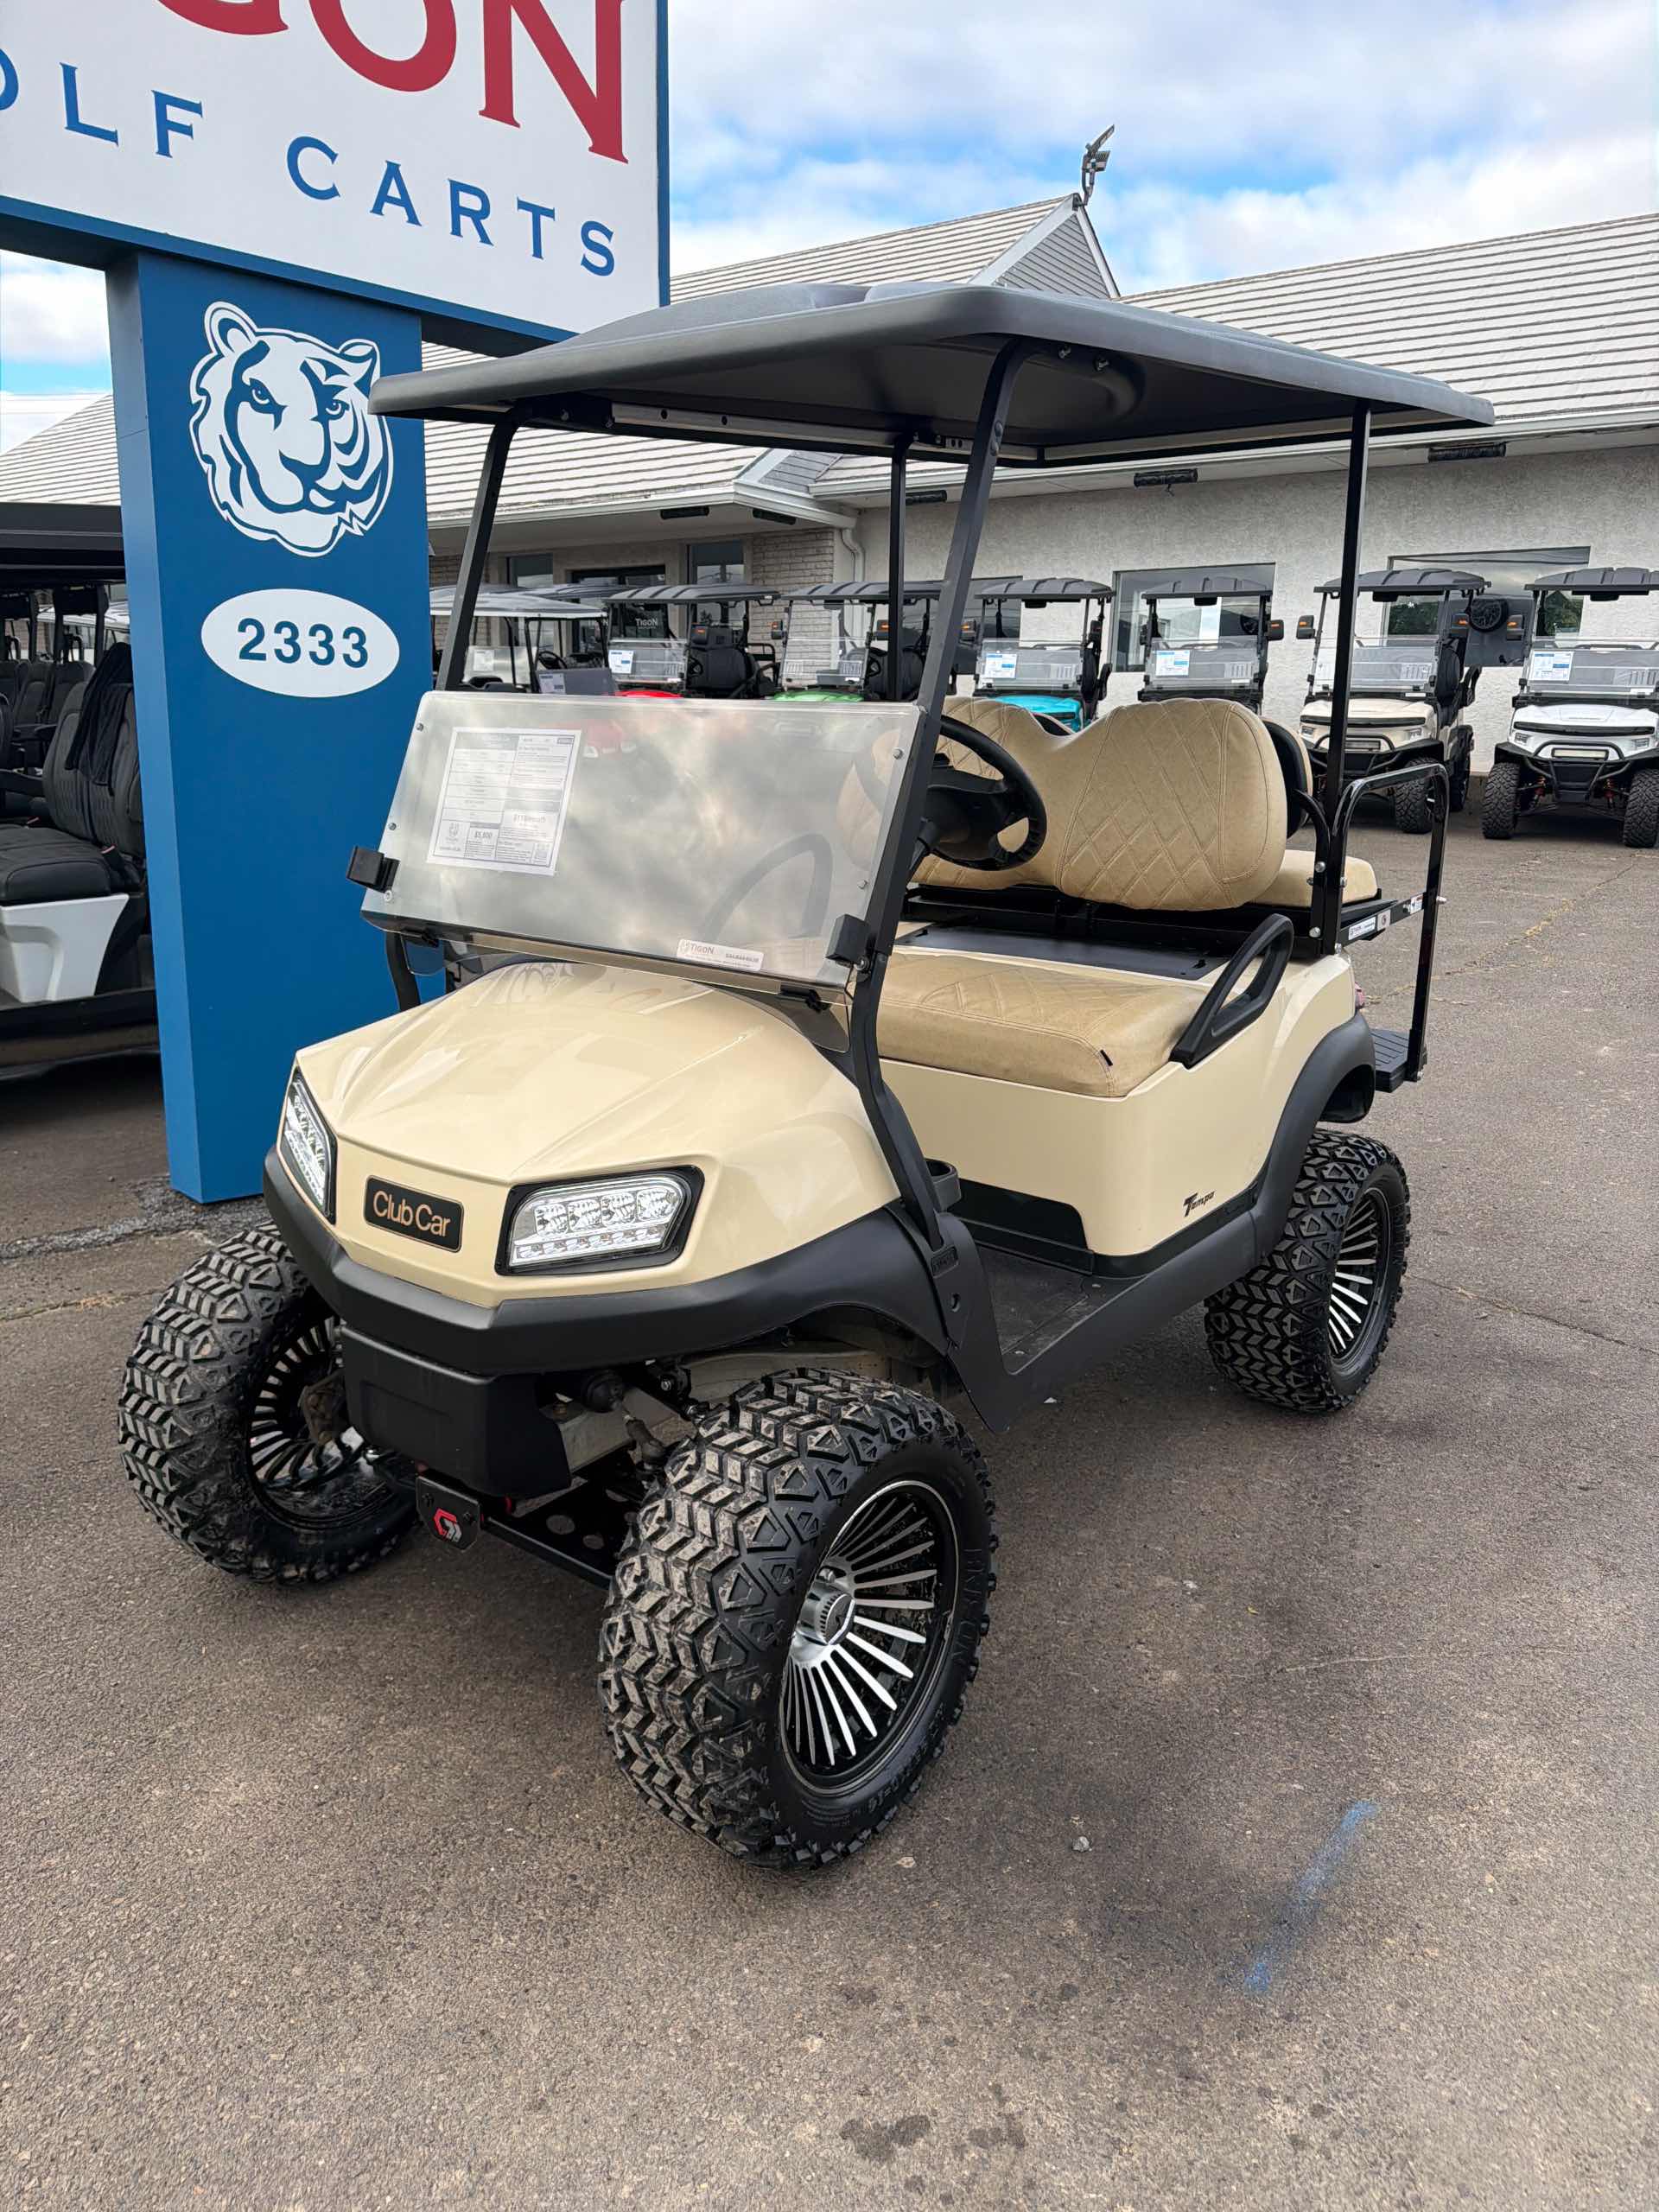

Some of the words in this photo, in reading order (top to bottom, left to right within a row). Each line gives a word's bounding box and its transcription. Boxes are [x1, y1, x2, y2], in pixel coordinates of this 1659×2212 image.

[286, 135, 616, 276] CARTS
[238, 618, 368, 668] 2333
[372, 1190, 414, 1226] Club
[416, 1204, 451, 1237] Car
